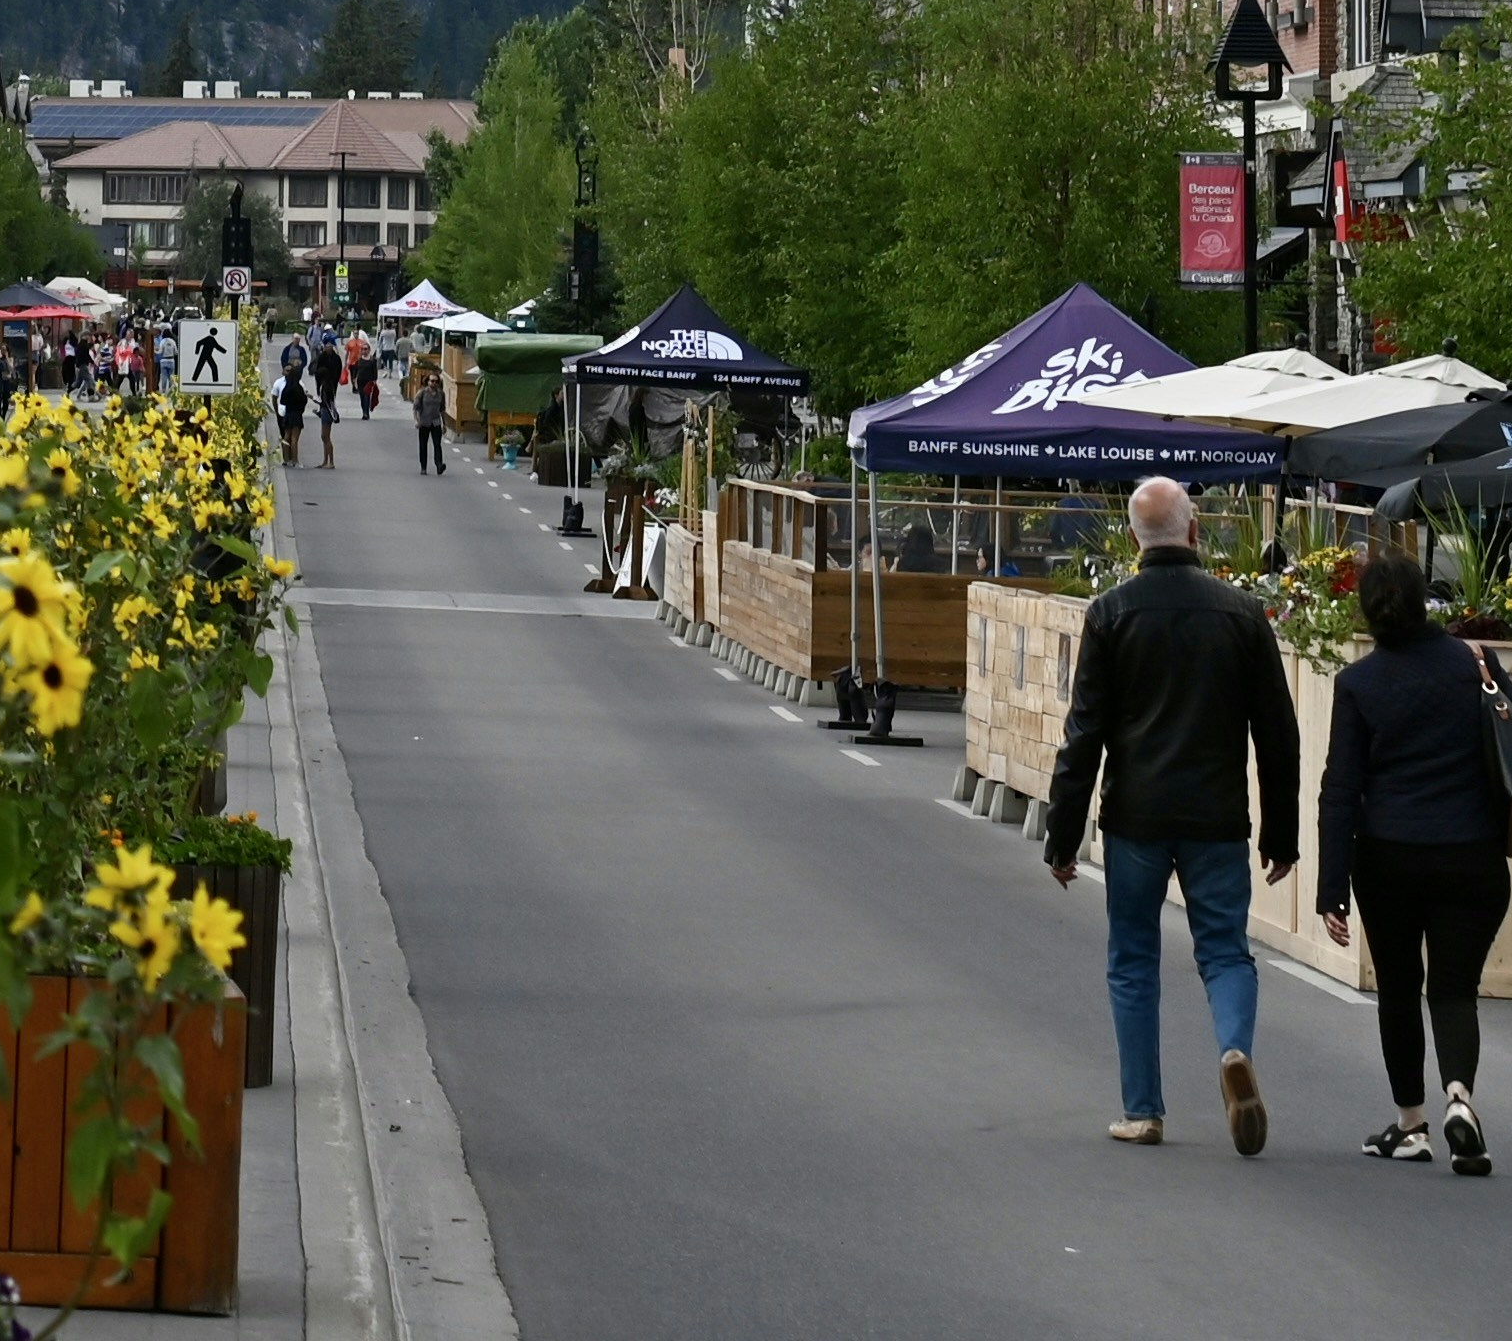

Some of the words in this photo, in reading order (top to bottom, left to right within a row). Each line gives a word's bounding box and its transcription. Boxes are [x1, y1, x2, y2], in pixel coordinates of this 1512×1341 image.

[1189, 183, 1235, 194] Berceau
[1202, 213, 1235, 222] Canada
[670, 329, 706, 342] THE
[641, 339, 707, 352] NORTH
[660, 348, 707, 359] FACE
[585, 365, 604, 374] THE
[606, 367, 638, 377] NORTH
[641, 369, 664, 378] FACE
[667, 371, 697, 380] BANFF
[713, 374, 729, 383] 124
[731, 375, 761, 385] BANFF
[764, 377, 801, 387] AVENUE
[908, 440, 958, 454] BANFF
[962, 441, 1039, 457] SUNSHINE
[1059, 444, 1097, 459] LAKE
[1101, 445, 1154, 461] LOUISE
[1174, 448, 1198, 462] MT.
[1202, 449, 1276, 465] NORQUAY
